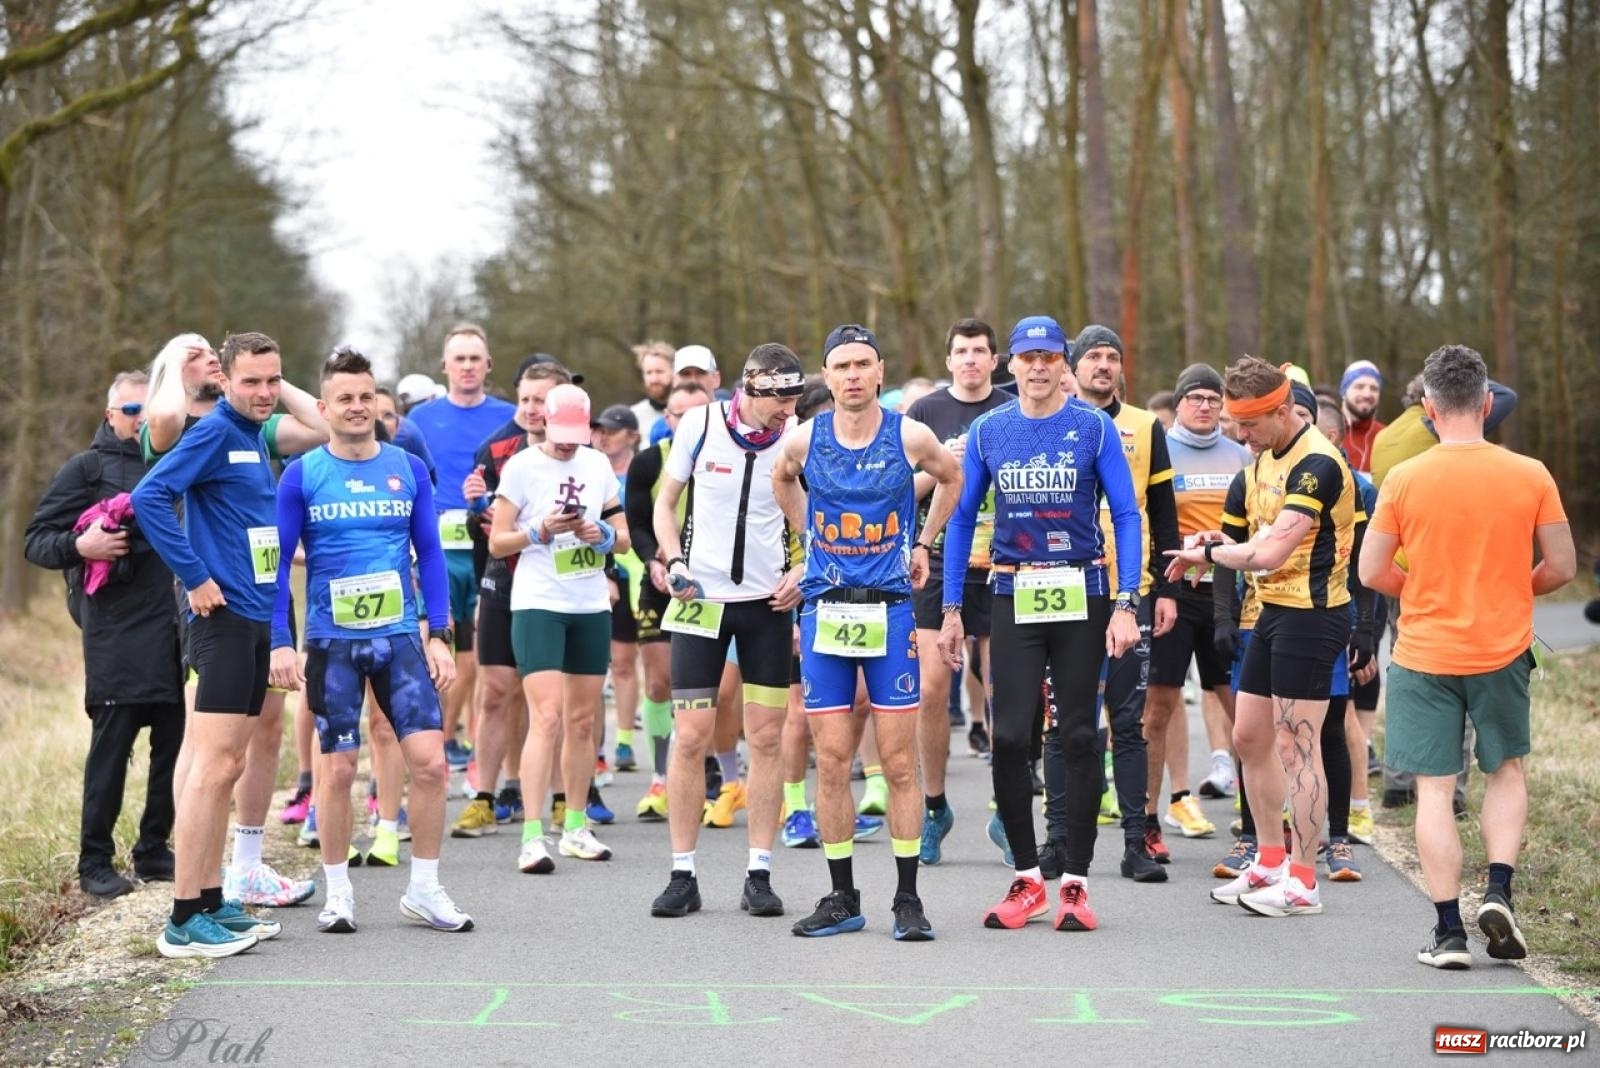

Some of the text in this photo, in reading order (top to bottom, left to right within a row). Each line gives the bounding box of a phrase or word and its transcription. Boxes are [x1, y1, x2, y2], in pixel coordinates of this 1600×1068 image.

[1000, 470, 1074, 489] SILESIAN
[1005, 492, 1073, 505] TRIATHLON TEAM
[308, 499, 413, 522] RUNNERS
[455, 524, 468, 540] 5
[571, 547, 596, 568] 40
[354, 593, 385, 619] 67
[1033, 588, 1067, 612] 53
[674, 601, 703, 624] 22
[834, 624, 867, 646] 42
